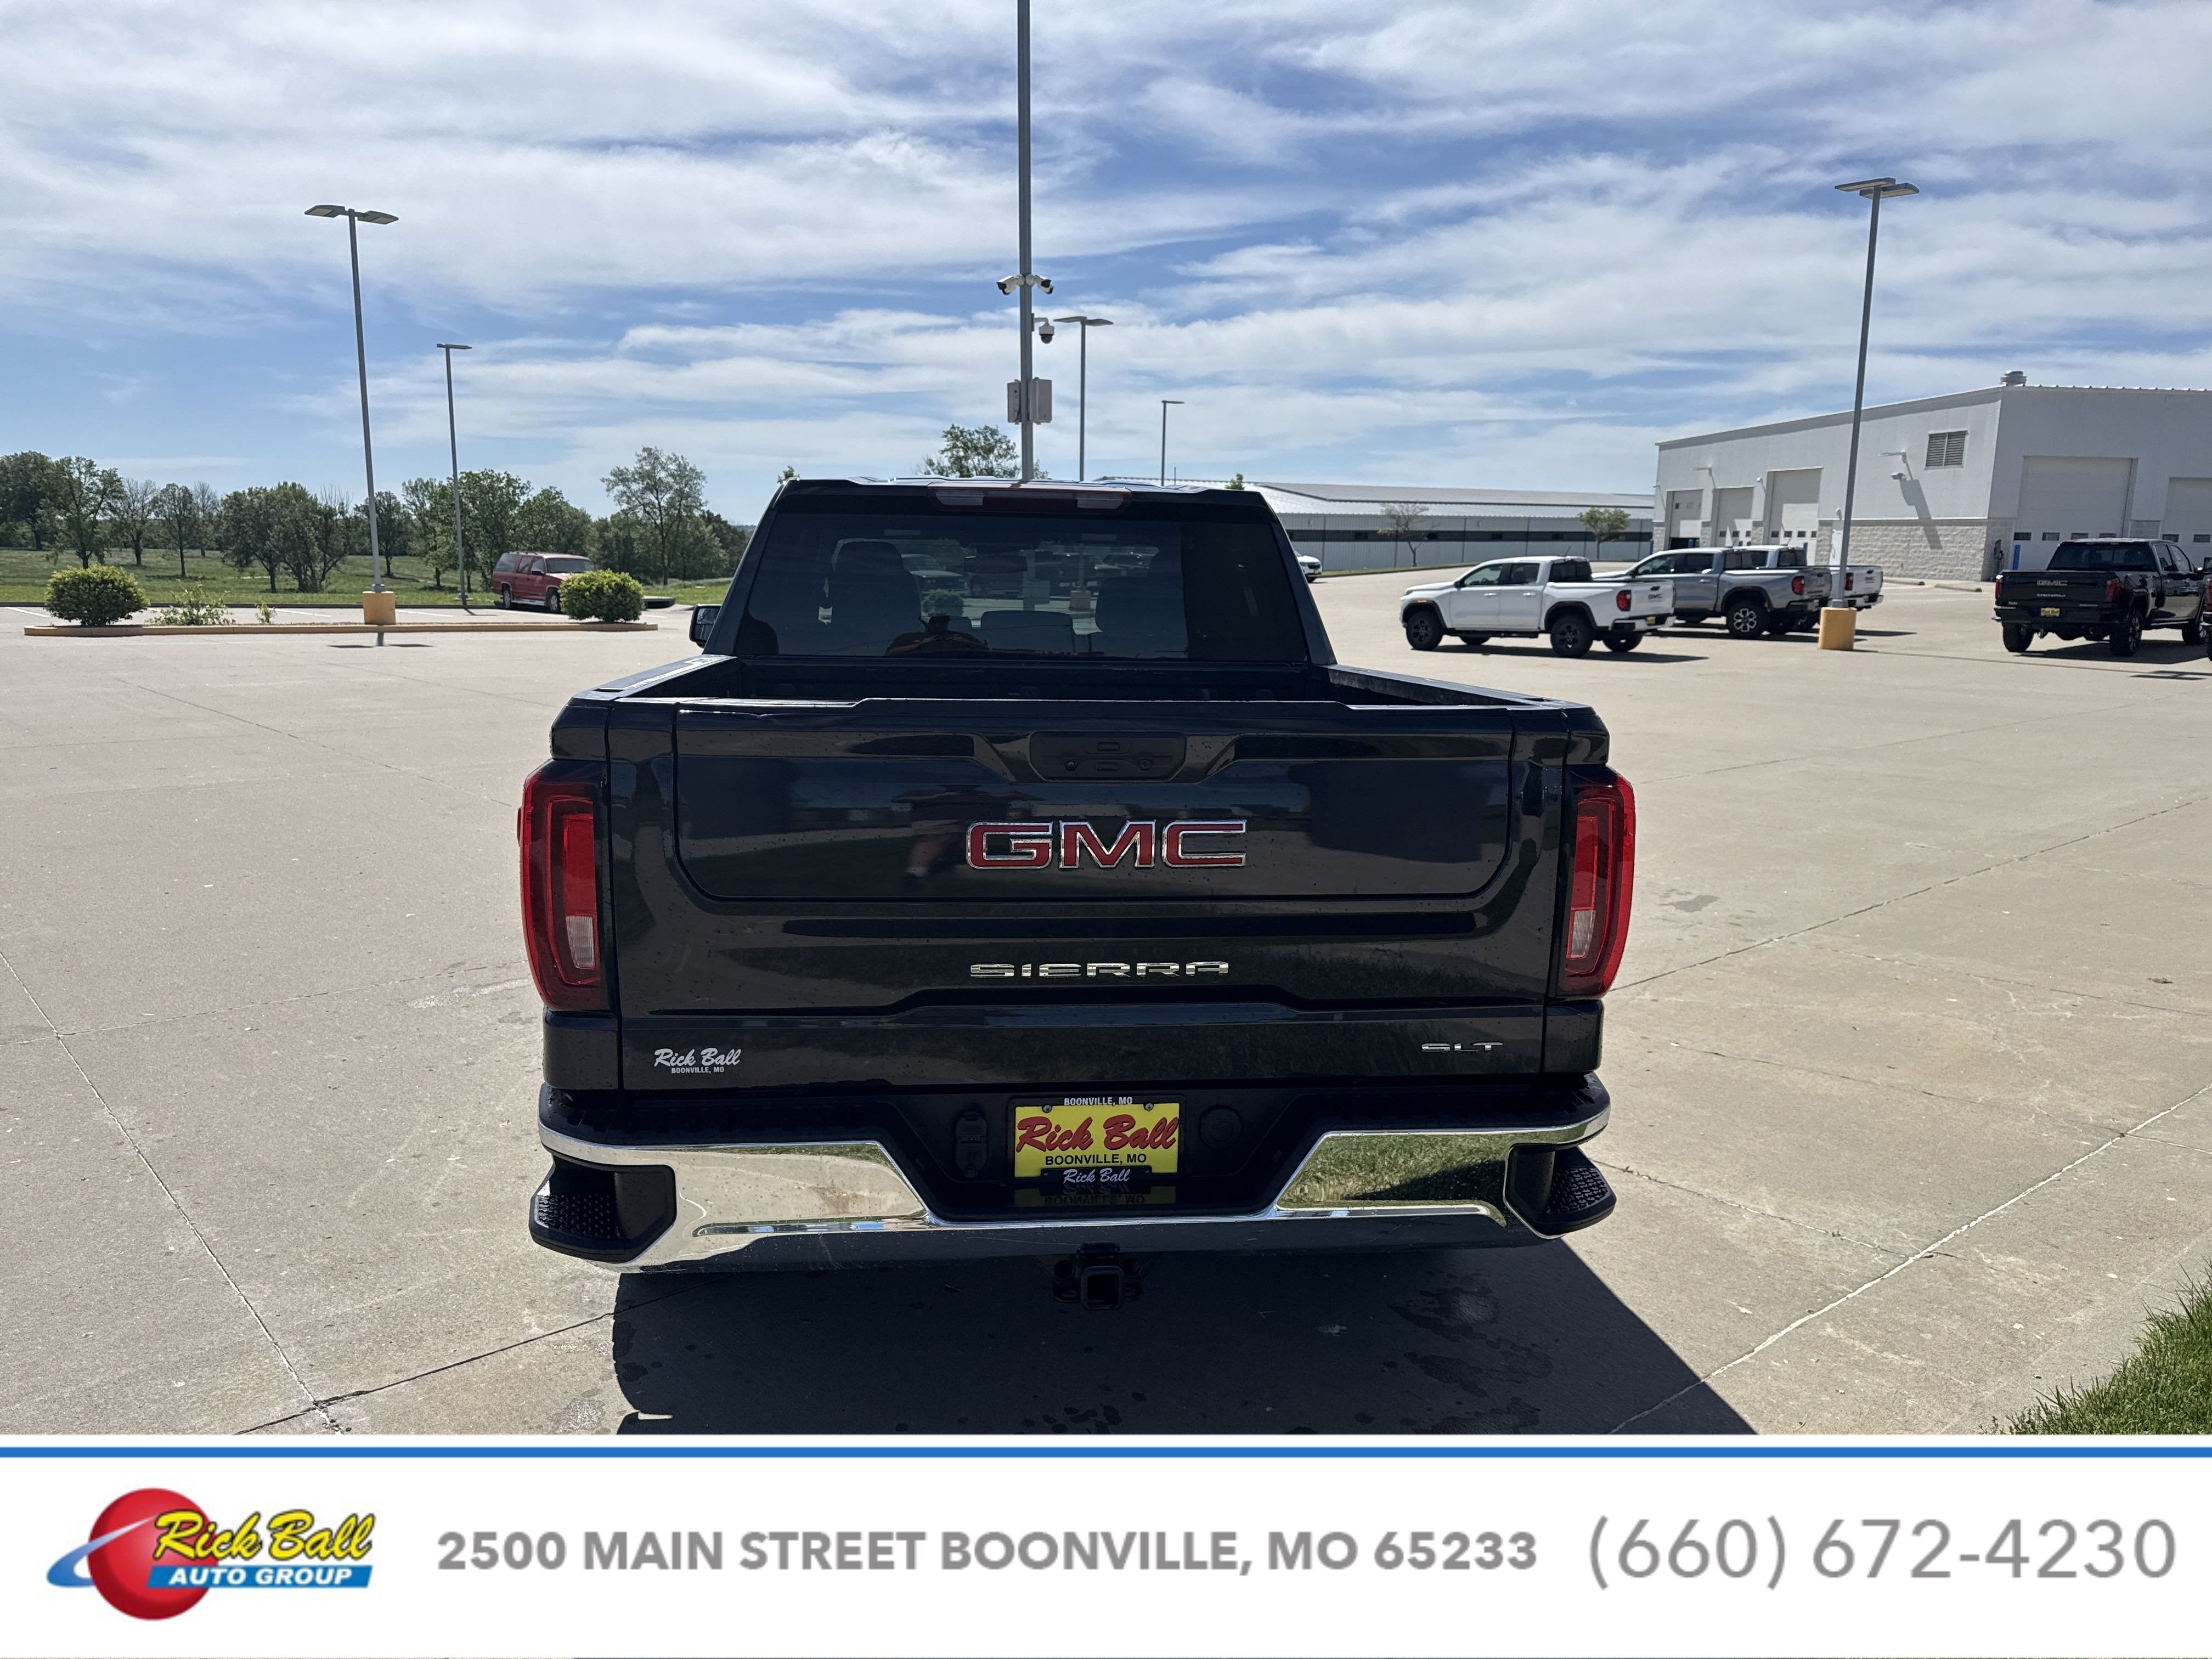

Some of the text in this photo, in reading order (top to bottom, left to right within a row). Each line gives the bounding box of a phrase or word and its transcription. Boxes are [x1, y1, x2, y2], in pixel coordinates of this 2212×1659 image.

[966, 820, 1246, 869] GMC
[970, 961, 1229, 978] SIERRA
[1421, 1042, 1503, 1053] SLT
[654, 1047, 741, 1066] Rick Ball
[1064, 1097, 1133, 1106] BOONVILLE, MO
[1015, 1114, 1179, 1153] Rick Ball
[1045, 1153, 1147, 1166] BOONVILLE, MO
[1063, 1167, 1130, 1184] Rick Ball
